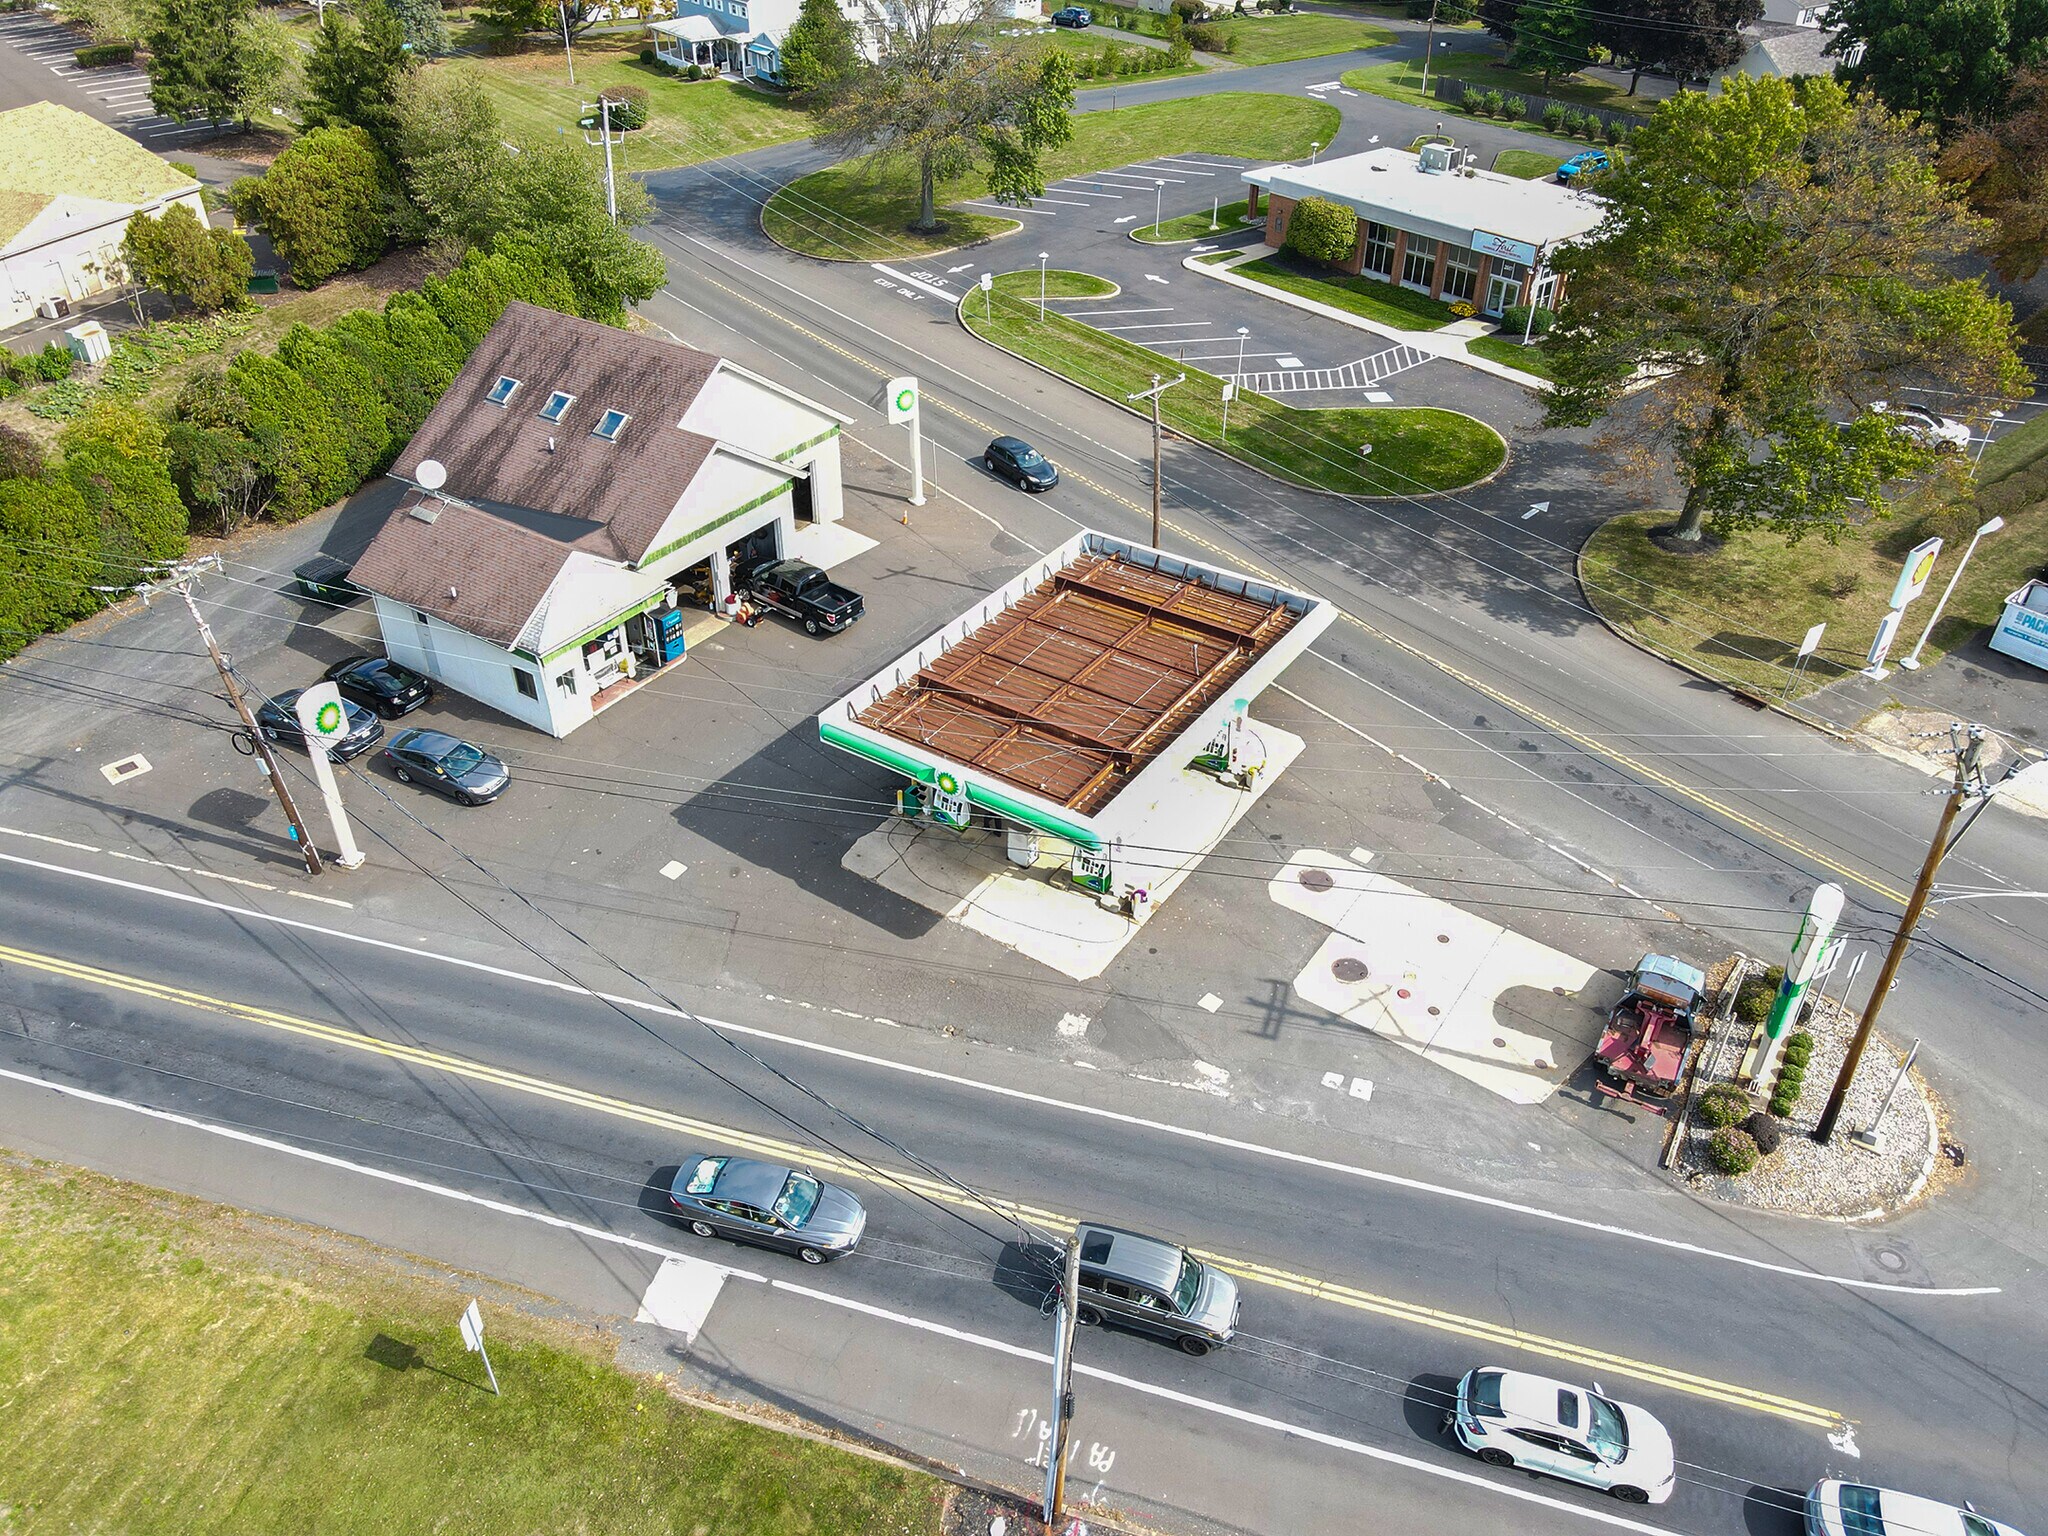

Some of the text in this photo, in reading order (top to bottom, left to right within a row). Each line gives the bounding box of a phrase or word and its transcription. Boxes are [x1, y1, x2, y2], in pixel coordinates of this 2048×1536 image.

[909, 271, 948, 287] STOP
[873, 278, 925, 300] EXIT ONLY
